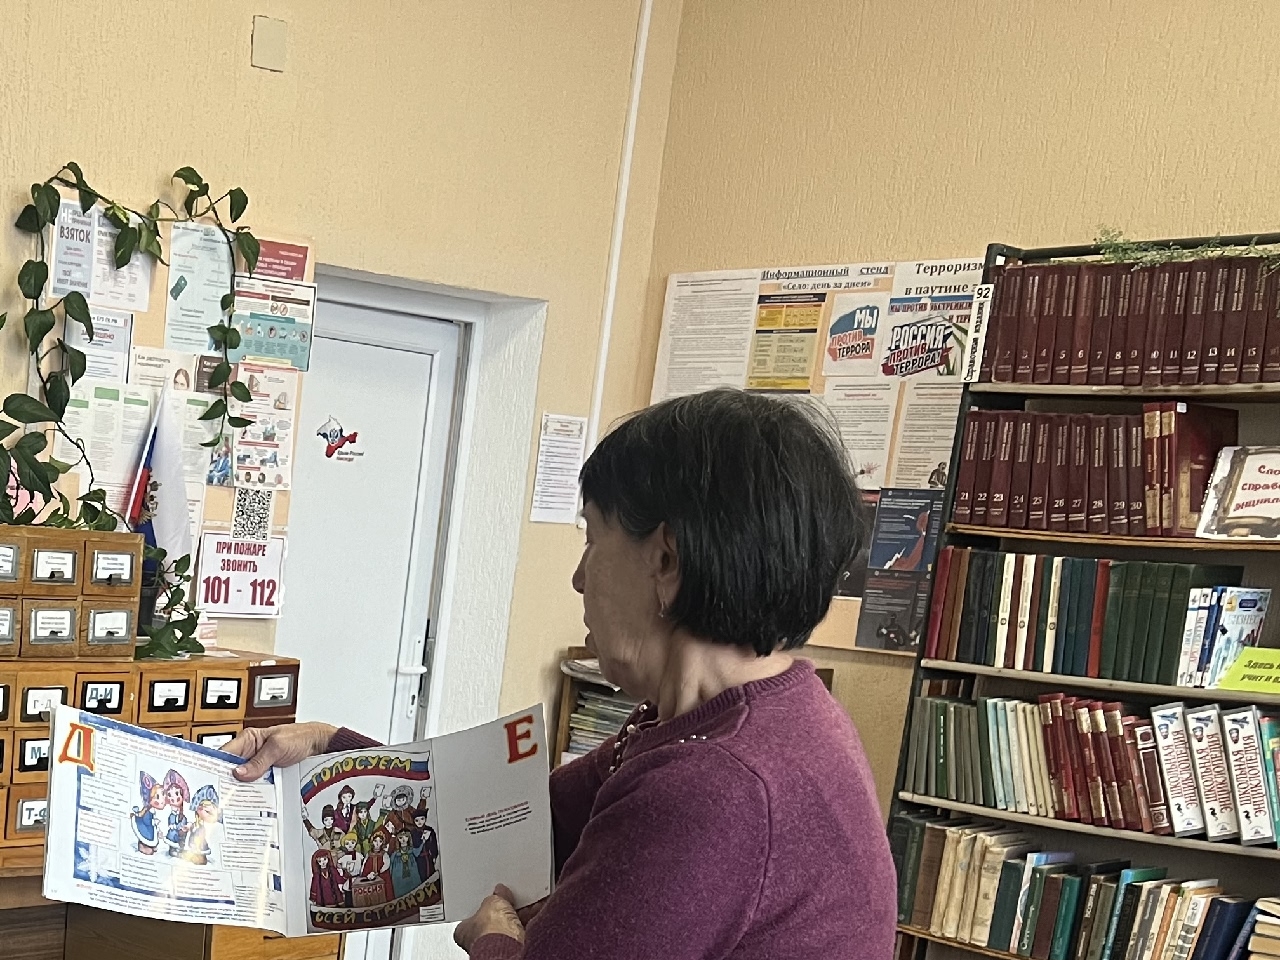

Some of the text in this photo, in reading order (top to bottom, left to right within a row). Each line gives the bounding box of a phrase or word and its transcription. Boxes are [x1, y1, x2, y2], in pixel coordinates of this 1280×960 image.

[60, 226, 91, 244] ВЗЯТОК
[761, 267, 850, 280] Информационный
[904, 284, 968, 296] в паутине
[976, 287, 990, 299] 92
[854, 309, 878, 328] МЫ
[902, 302, 928, 312] ПРОТИВ
[831, 330, 864, 346] ПРОТИВ
[891, 325, 946, 350] РОССИЯ
[838, 341, 871, 358] ТЕРРОРА
[888, 342, 928, 365] ПРОТИВ
[894, 352, 942, 374] ТЕРРОРА!
[216, 541, 267, 556] ПРИ ПОЖАРЕ
[220, 558, 258, 572] ЗВОНИТЬ
[202, 576, 276, 606] 101 112
[58, 722, 96, 772] Д
[504, 714, 538, 764] Е
[312, 754, 412, 787] ГОЛОСУЕМ
[1162, 744, 1182, 799] ШКОЛЬНАЯ
[1171, 729, 1198, 809] ЭНЦИКЛОПЕДИЯ
[1196, 747, 1217, 803] ШКОЛЬНАЯ
[1207, 732, 1233, 813] ЭНЦИКЛОПЕДИЯ
[1232, 749, 1252, 806] ШКОЛЬНАЯ
[1243, 734, 1266, 817] ЭНЦИКЛОПЕДИЯ
[354, 884, 382, 896] РОССИЯ
[314, 882, 438, 924] ВСЕЙ СТРАНОЙ
